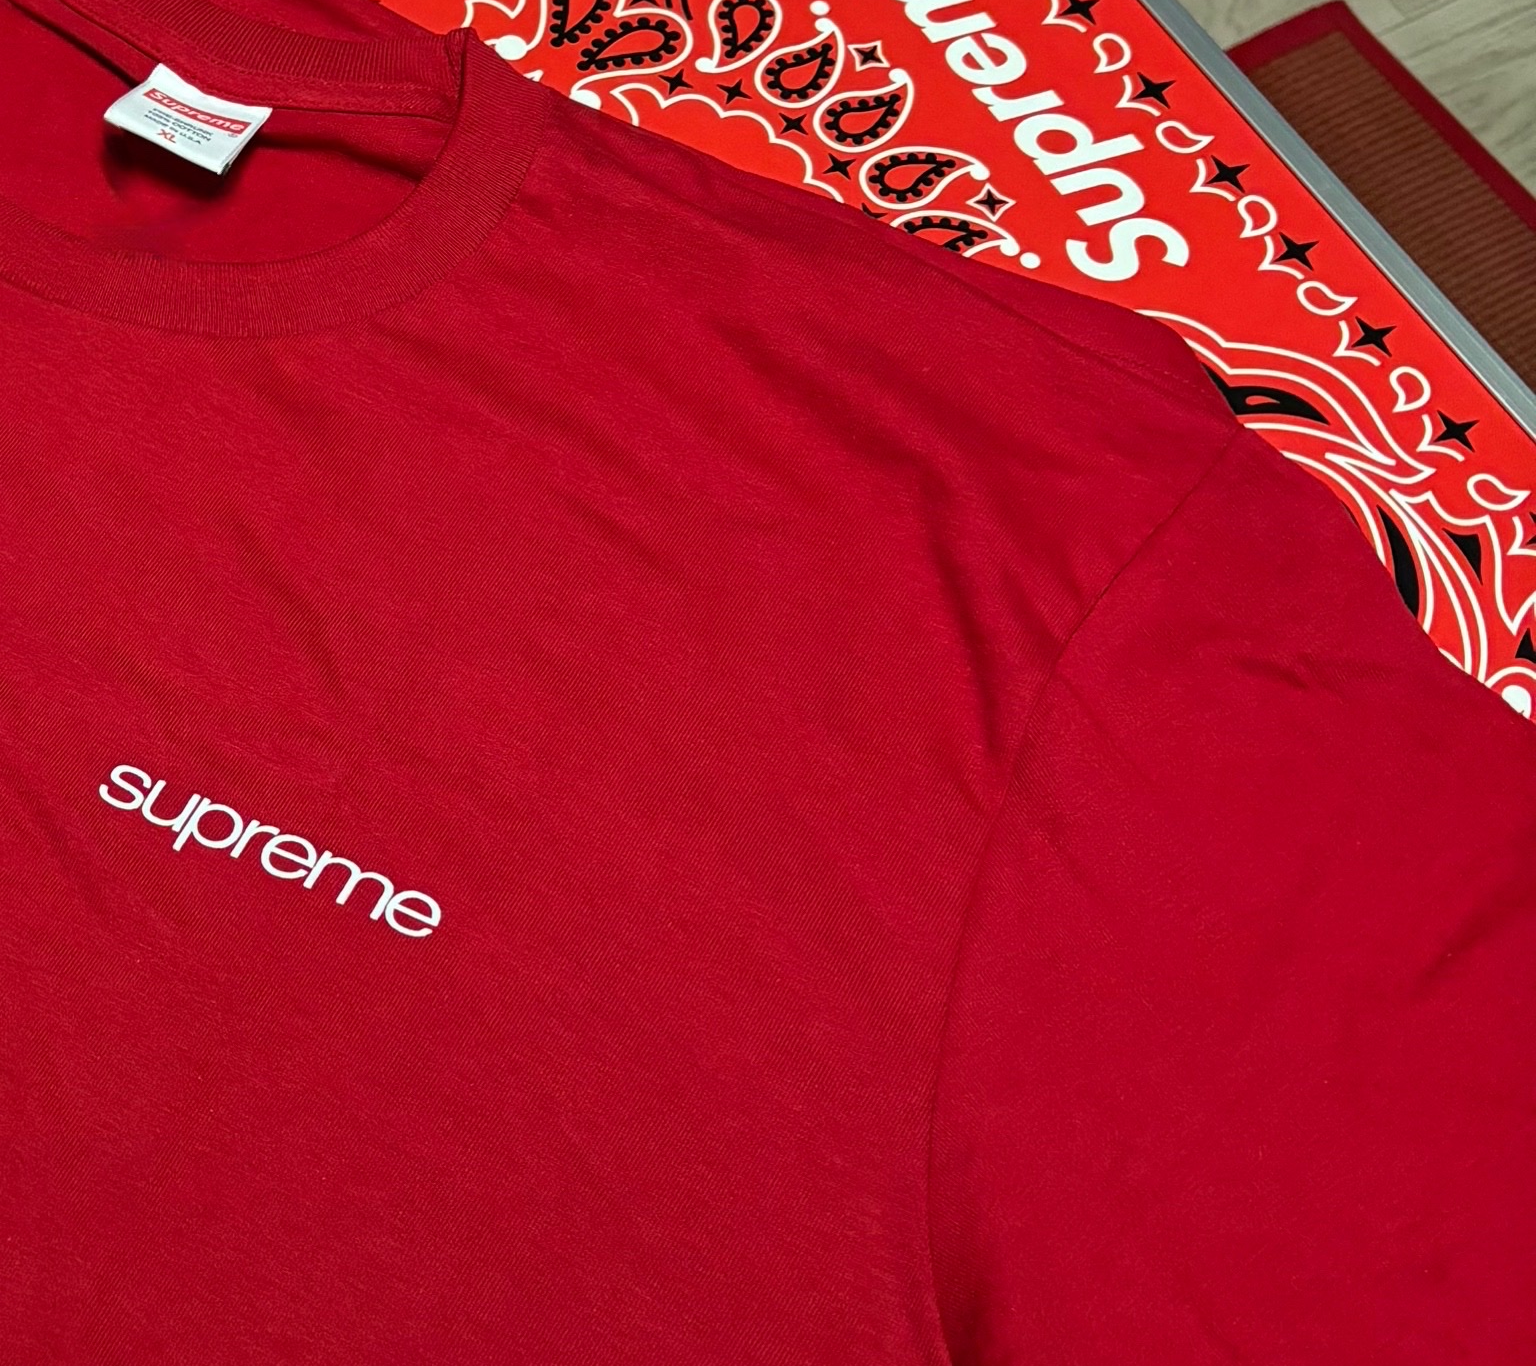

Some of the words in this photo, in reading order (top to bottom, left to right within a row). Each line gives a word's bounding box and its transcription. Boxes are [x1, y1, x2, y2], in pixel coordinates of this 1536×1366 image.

[149, 91, 245, 131] Supreme
[157, 128, 177, 144] XL
[171, 121, 212, 142] COTTON
[98, 764, 442, 938] supreme
